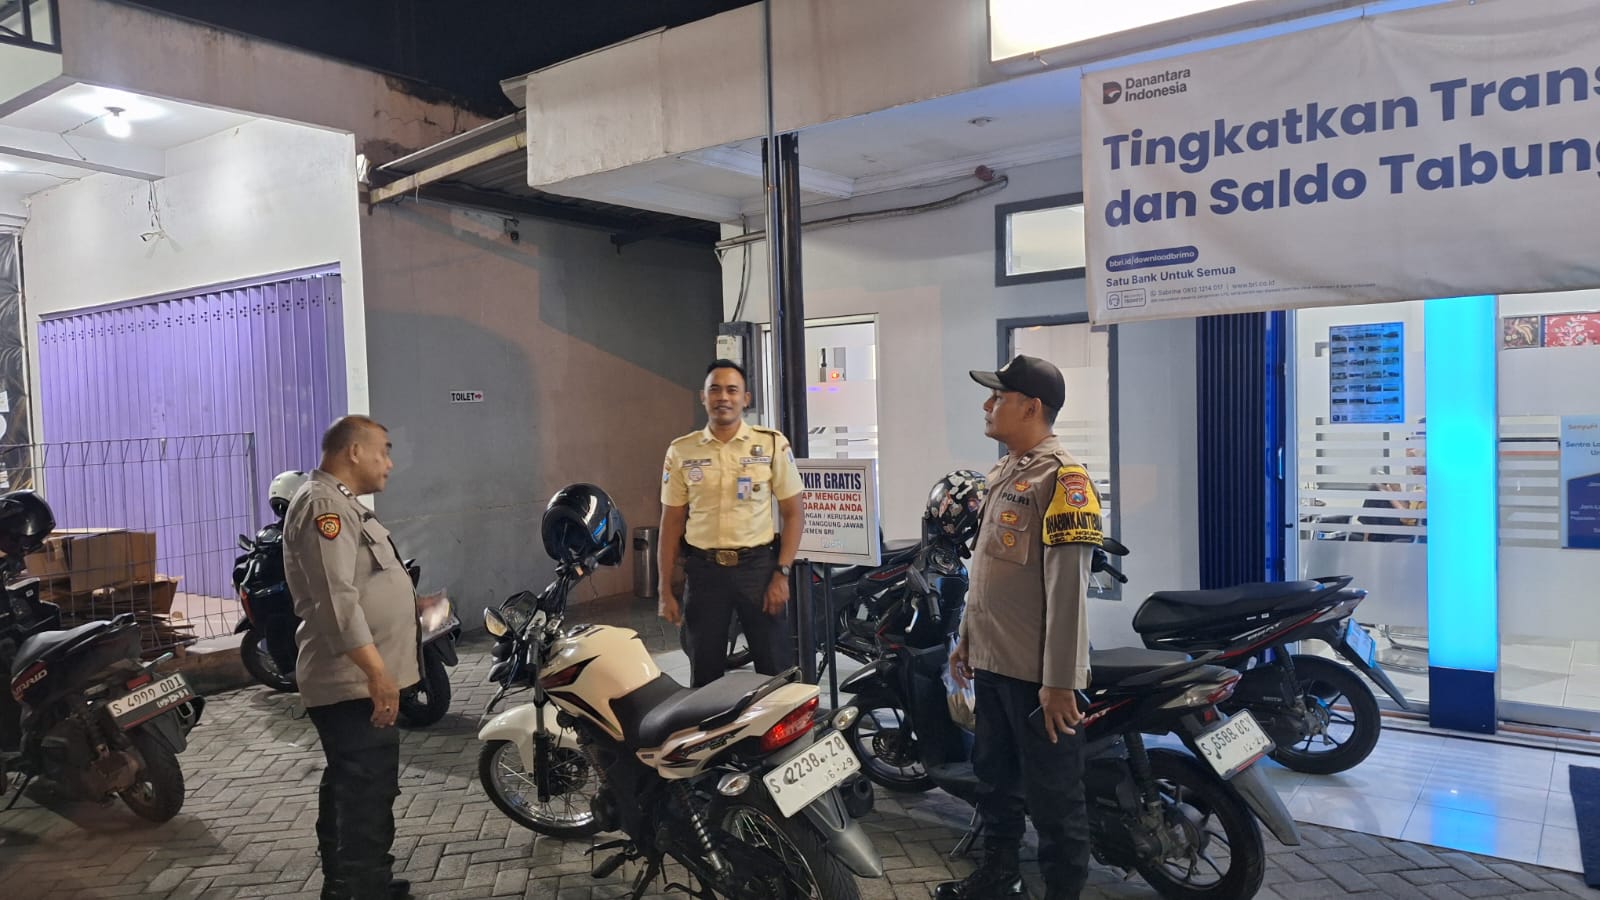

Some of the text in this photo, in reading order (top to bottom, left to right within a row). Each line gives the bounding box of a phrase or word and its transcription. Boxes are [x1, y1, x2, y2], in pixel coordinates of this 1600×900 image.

[1125, 68, 1191, 90] Danantara
[1124, 81, 1188, 102] Indonesia
[1102, 95, 1418, 174] Tingkatkan
[1104, 138, 1600, 228] dan Saldo Tabun
[1109, 250, 1195, 267] bbri.id/downloadbrimo
[1106, 265, 1237, 288] Satu Bank Untuk Semua
[451, 392, 475, 402] TOILET
[824, 472, 862, 490] GRATIS
[815, 492, 861, 502] MENGUNCI
[1002, 491, 1030, 506] POLRI
[839, 503, 863, 513] ANDA
[809, 520, 841, 529] TANGGUNG
[843, 521, 865, 530] JAWAB
[827, 513, 864, 521] KERUSAKAN
[112, 703, 123, 715] S
[1200, 742, 1212, 756] S
[1211, 727, 1237, 750] 6588
[769, 778, 781, 794] S
[783, 753, 820, 785] 2238
